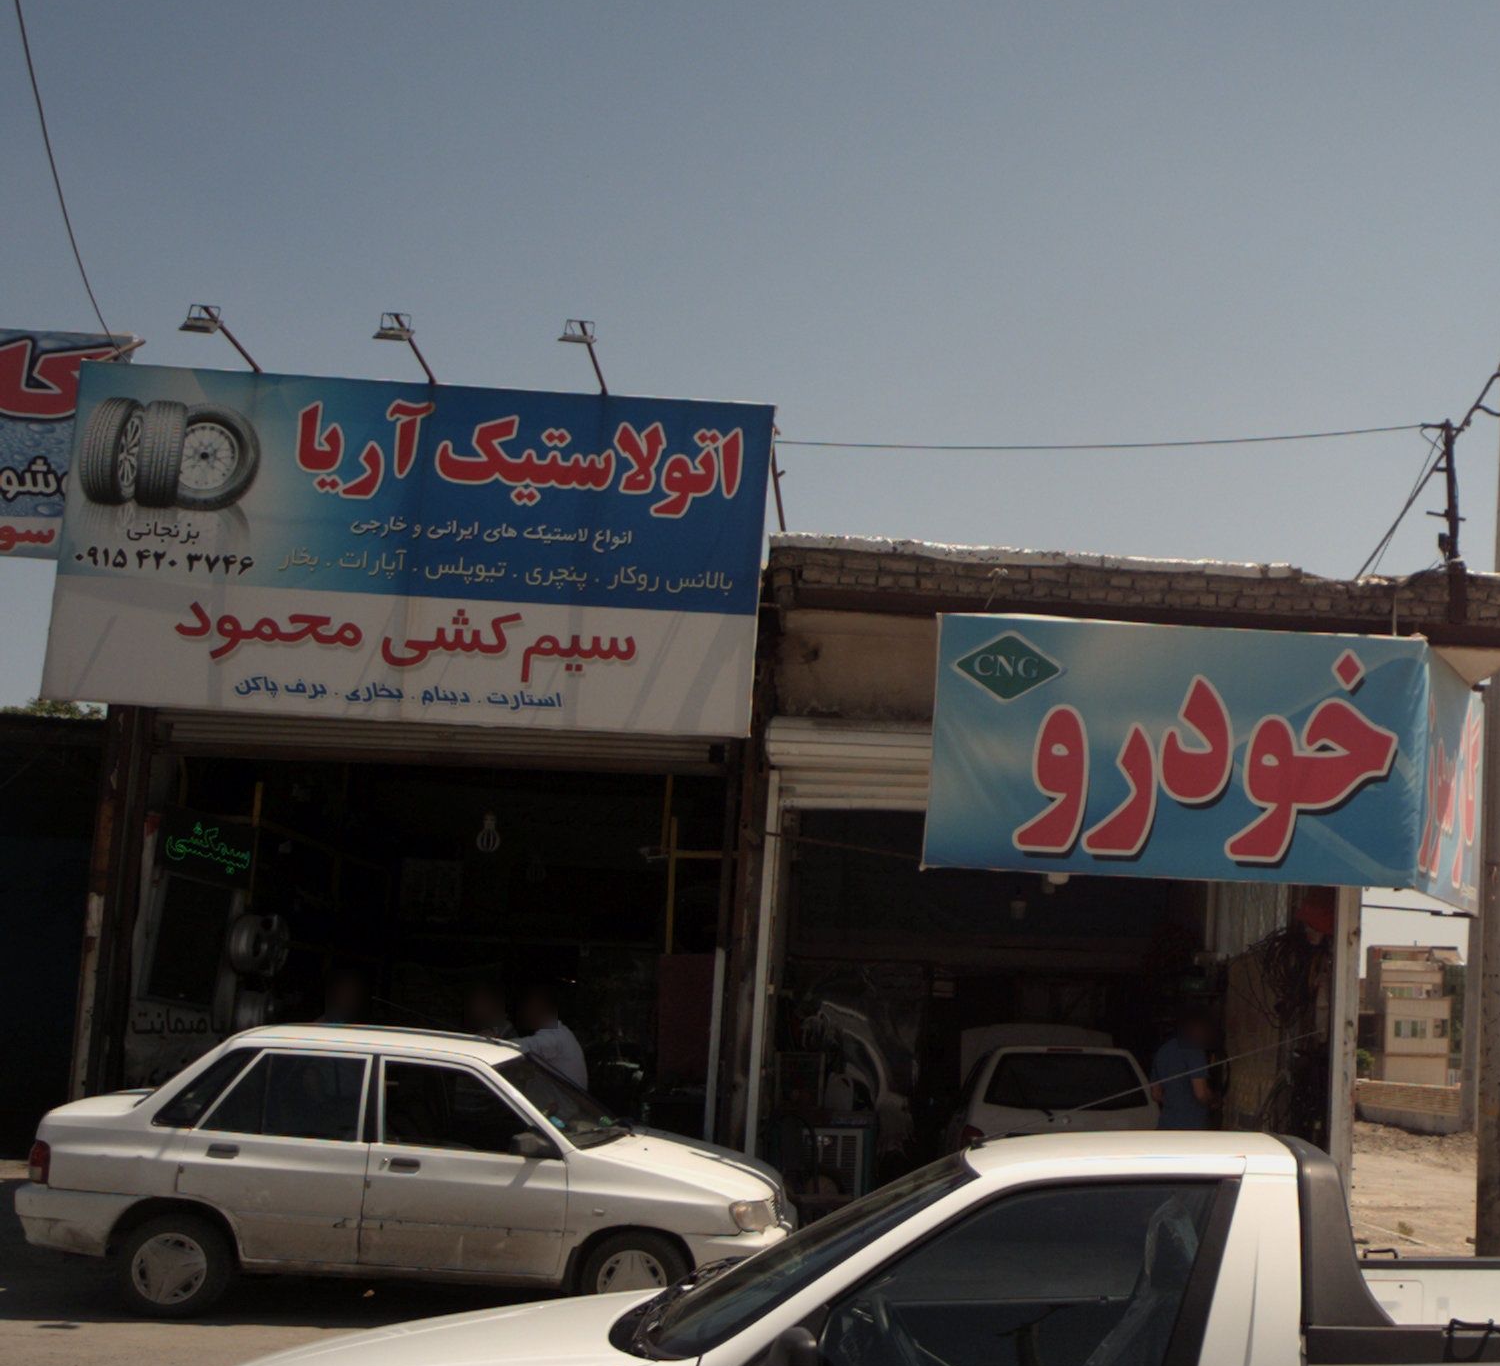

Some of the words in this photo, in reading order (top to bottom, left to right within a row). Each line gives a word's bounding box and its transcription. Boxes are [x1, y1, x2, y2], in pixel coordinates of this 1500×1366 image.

[297, 399, 435, 500] آریا
[127, 521, 200, 545] بزنجانی
[351, 516, 407, 538] خارجی
[413, 523, 421, 538] و
[427, 520, 479, 542] ایرانی
[483, 523, 517, 542] های
[523, 524, 588, 544] لاستیک
[593, 529, 633, 552] انواع
[75, 546, 127, 569] ۰۹۱۵
[186, 553, 254, 576] ۳۷۴۶
[278, 547, 319, 572] بخار
[339, 549, 407, 579] آپارات
[425, 556, 507, 584] تیوپلس
[526, 566, 587, 591] پنچری
[608, 566, 659, 592] روکار
[666, 571, 733, 596] بالانس
[175, 601, 363, 660] محمود
[381, 608, 523, 668] کشی
[521, 631, 637, 683] سیم
[974, 654, 1039, 679] CNG
[235, 676, 278, 698] پاکن
[285, 678, 327, 699] برف
[345, 682, 404, 702] بخاری
[421, 686, 470, 705] دینام
[487, 690, 562, 710] استارت
[1012, 647, 1398, 862] خودرو
